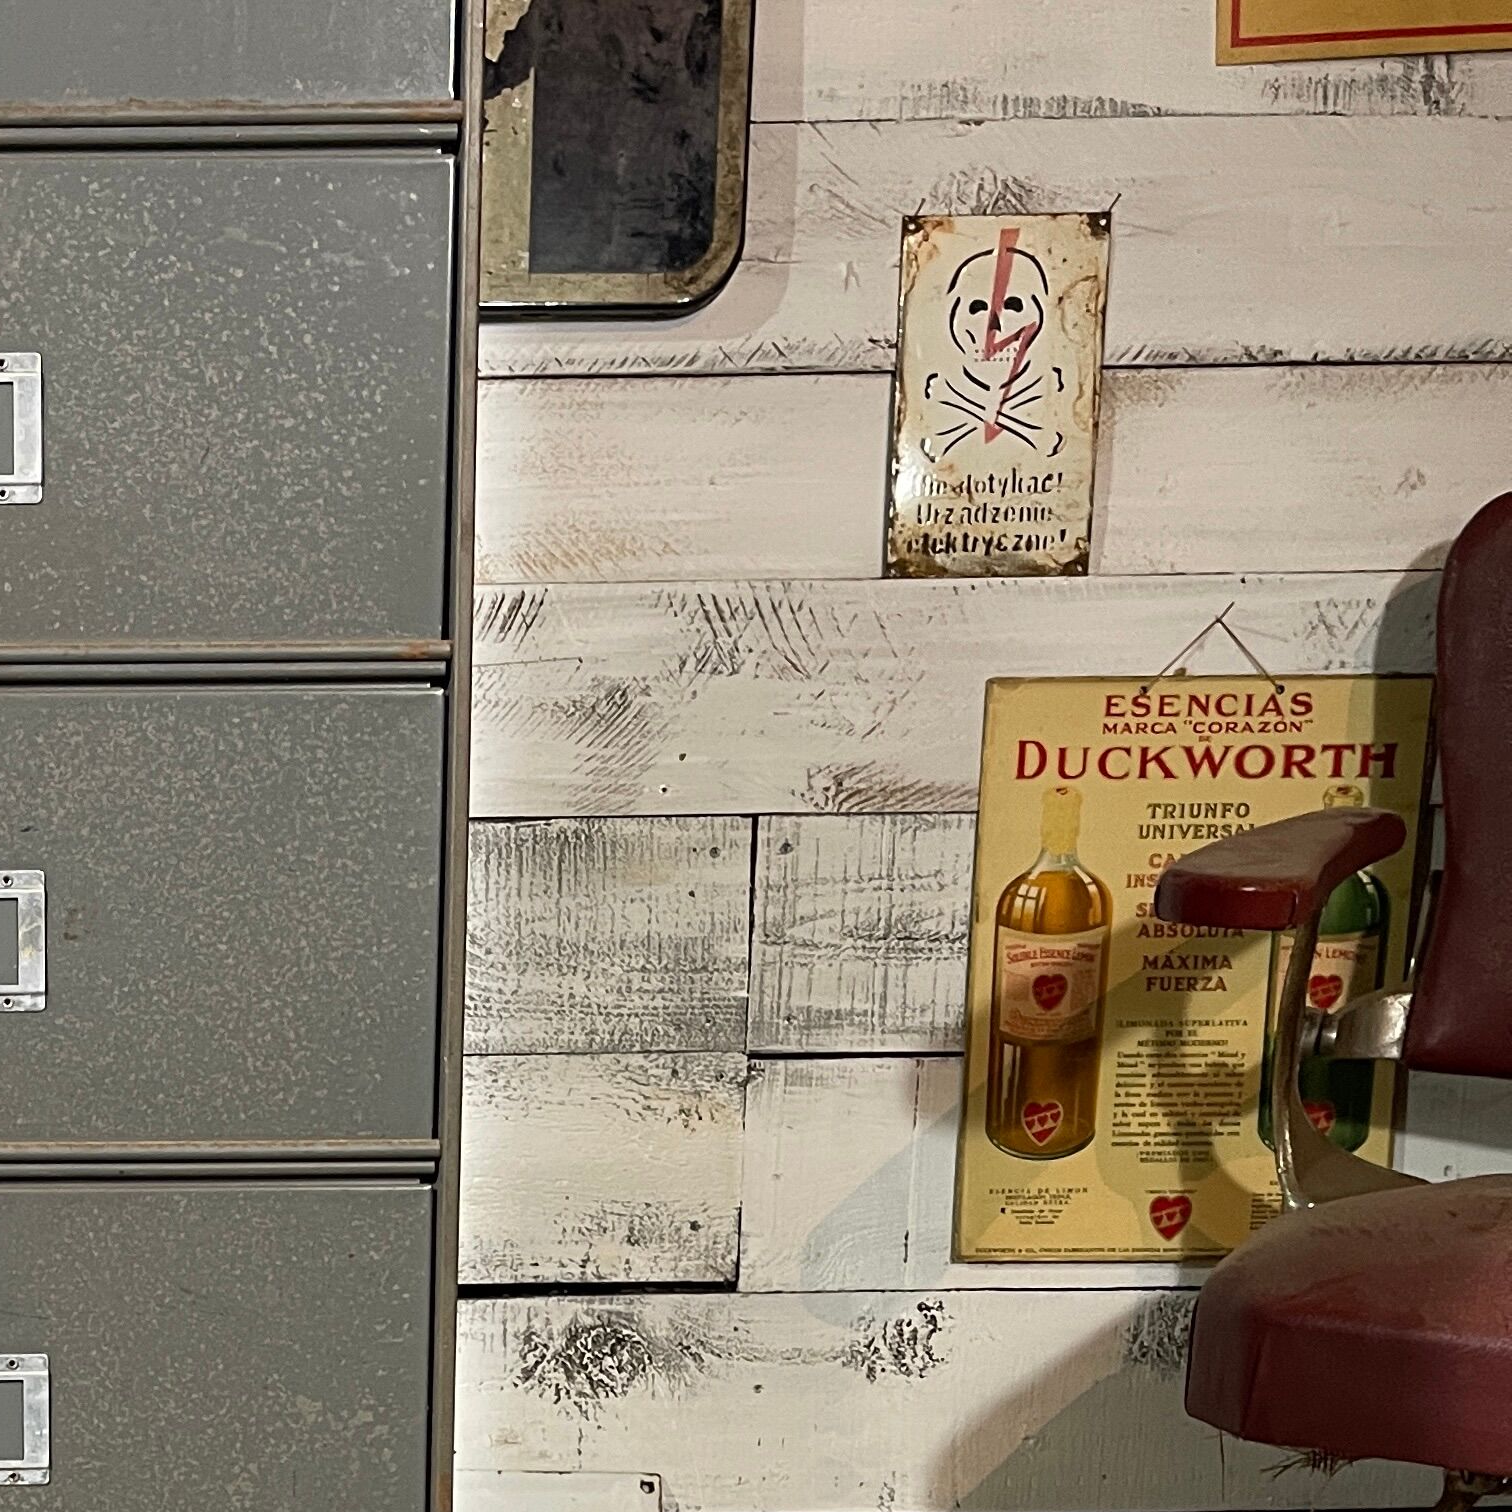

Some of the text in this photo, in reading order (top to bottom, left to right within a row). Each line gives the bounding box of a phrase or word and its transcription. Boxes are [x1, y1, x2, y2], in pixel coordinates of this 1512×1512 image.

[1104, 692, 1314, 718] ESENCIAS
[1102, 722, 1177, 735] MARCA
[1015, 741, 1398, 780] DUCKWORTH
[1146, 803, 1251, 819] TRIUNFO
[1146, 976, 1228, 992] FUERZA
